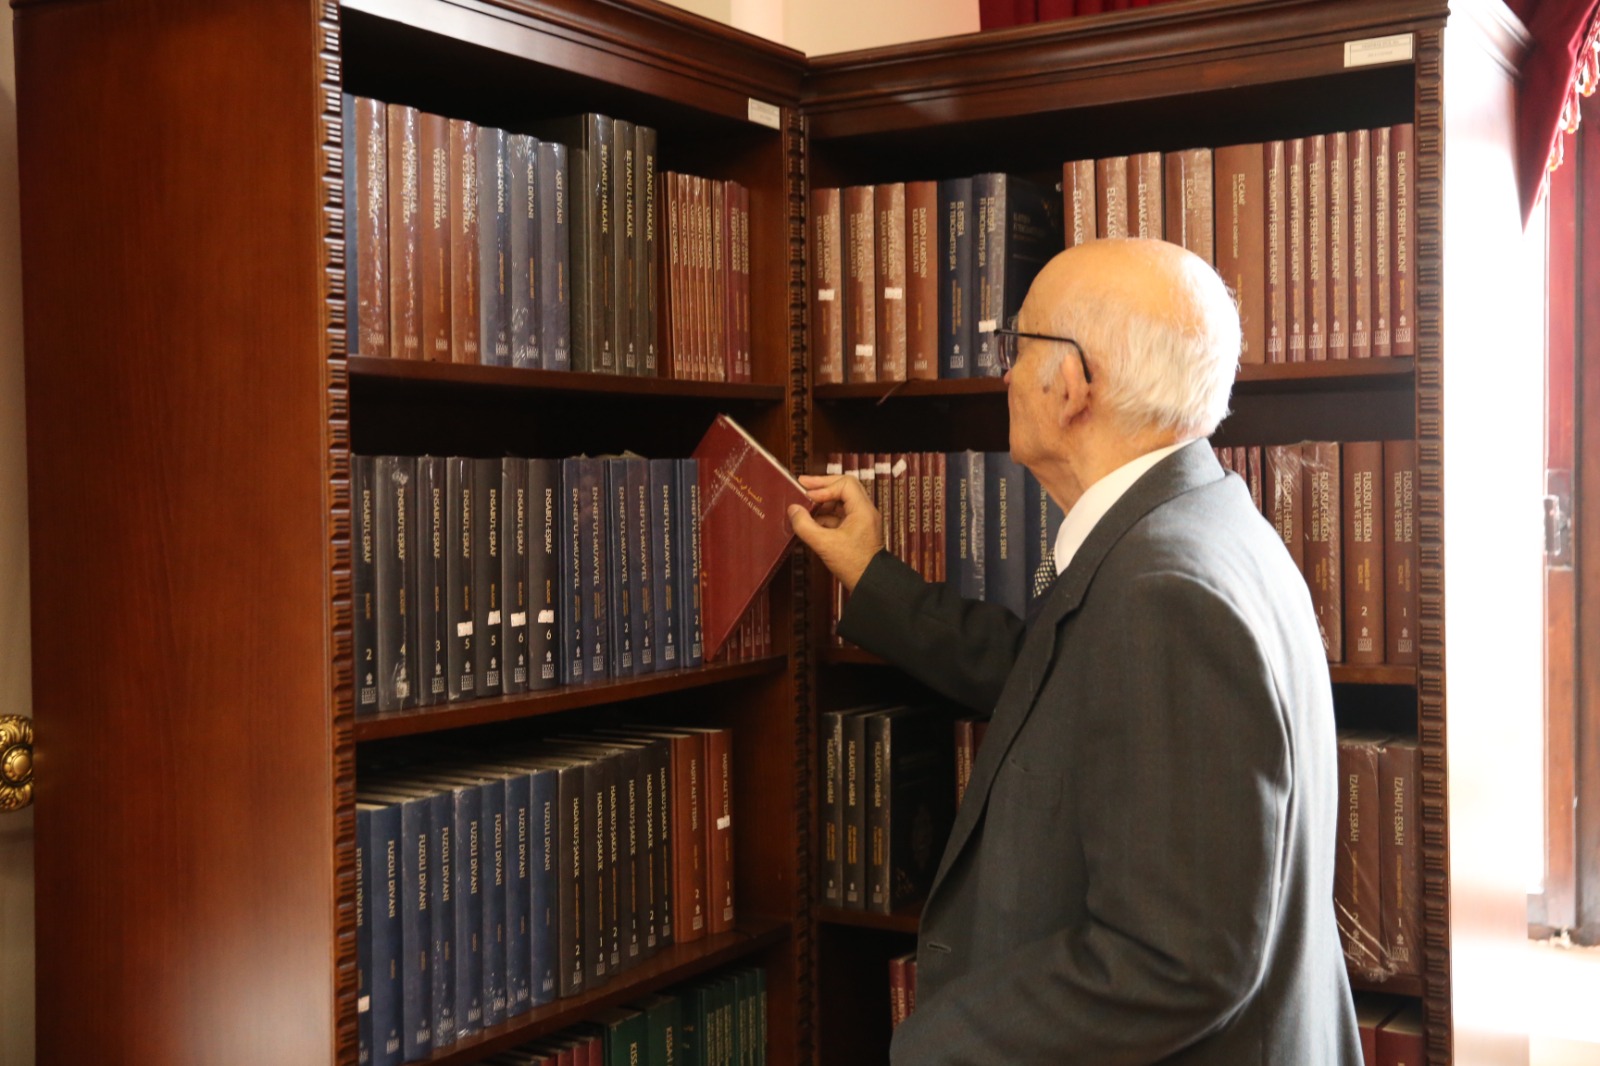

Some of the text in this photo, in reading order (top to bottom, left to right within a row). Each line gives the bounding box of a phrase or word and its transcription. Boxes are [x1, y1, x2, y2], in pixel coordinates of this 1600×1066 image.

[1312, 509, 1319, 518] VE
[1355, 509, 1361, 519] VE
[1395, 509, 1402, 519] VE
[960, 528, 966, 537] VE
[1001, 528, 1007, 537] VE
[1040, 529, 1047, 537] VE
[1361, 606, 1367, 616] 2
[645, 620, 648, 630] 1
[668, 617, 671, 626] 1
[695, 615, 698, 625] 2
[596, 626, 599, 636] 1
[624, 623, 629, 633] 2
[518, 632, 523, 643] 6
[546, 629, 551, 640] 6
[576, 629, 580, 640] 2
[436, 640, 440, 651] 3
[465, 638, 470, 649] 5
[491, 635, 496, 646] 5
[400, 643, 406, 654] 4
[366, 648, 372, 660] 2
[695, 889, 699, 899] 2
